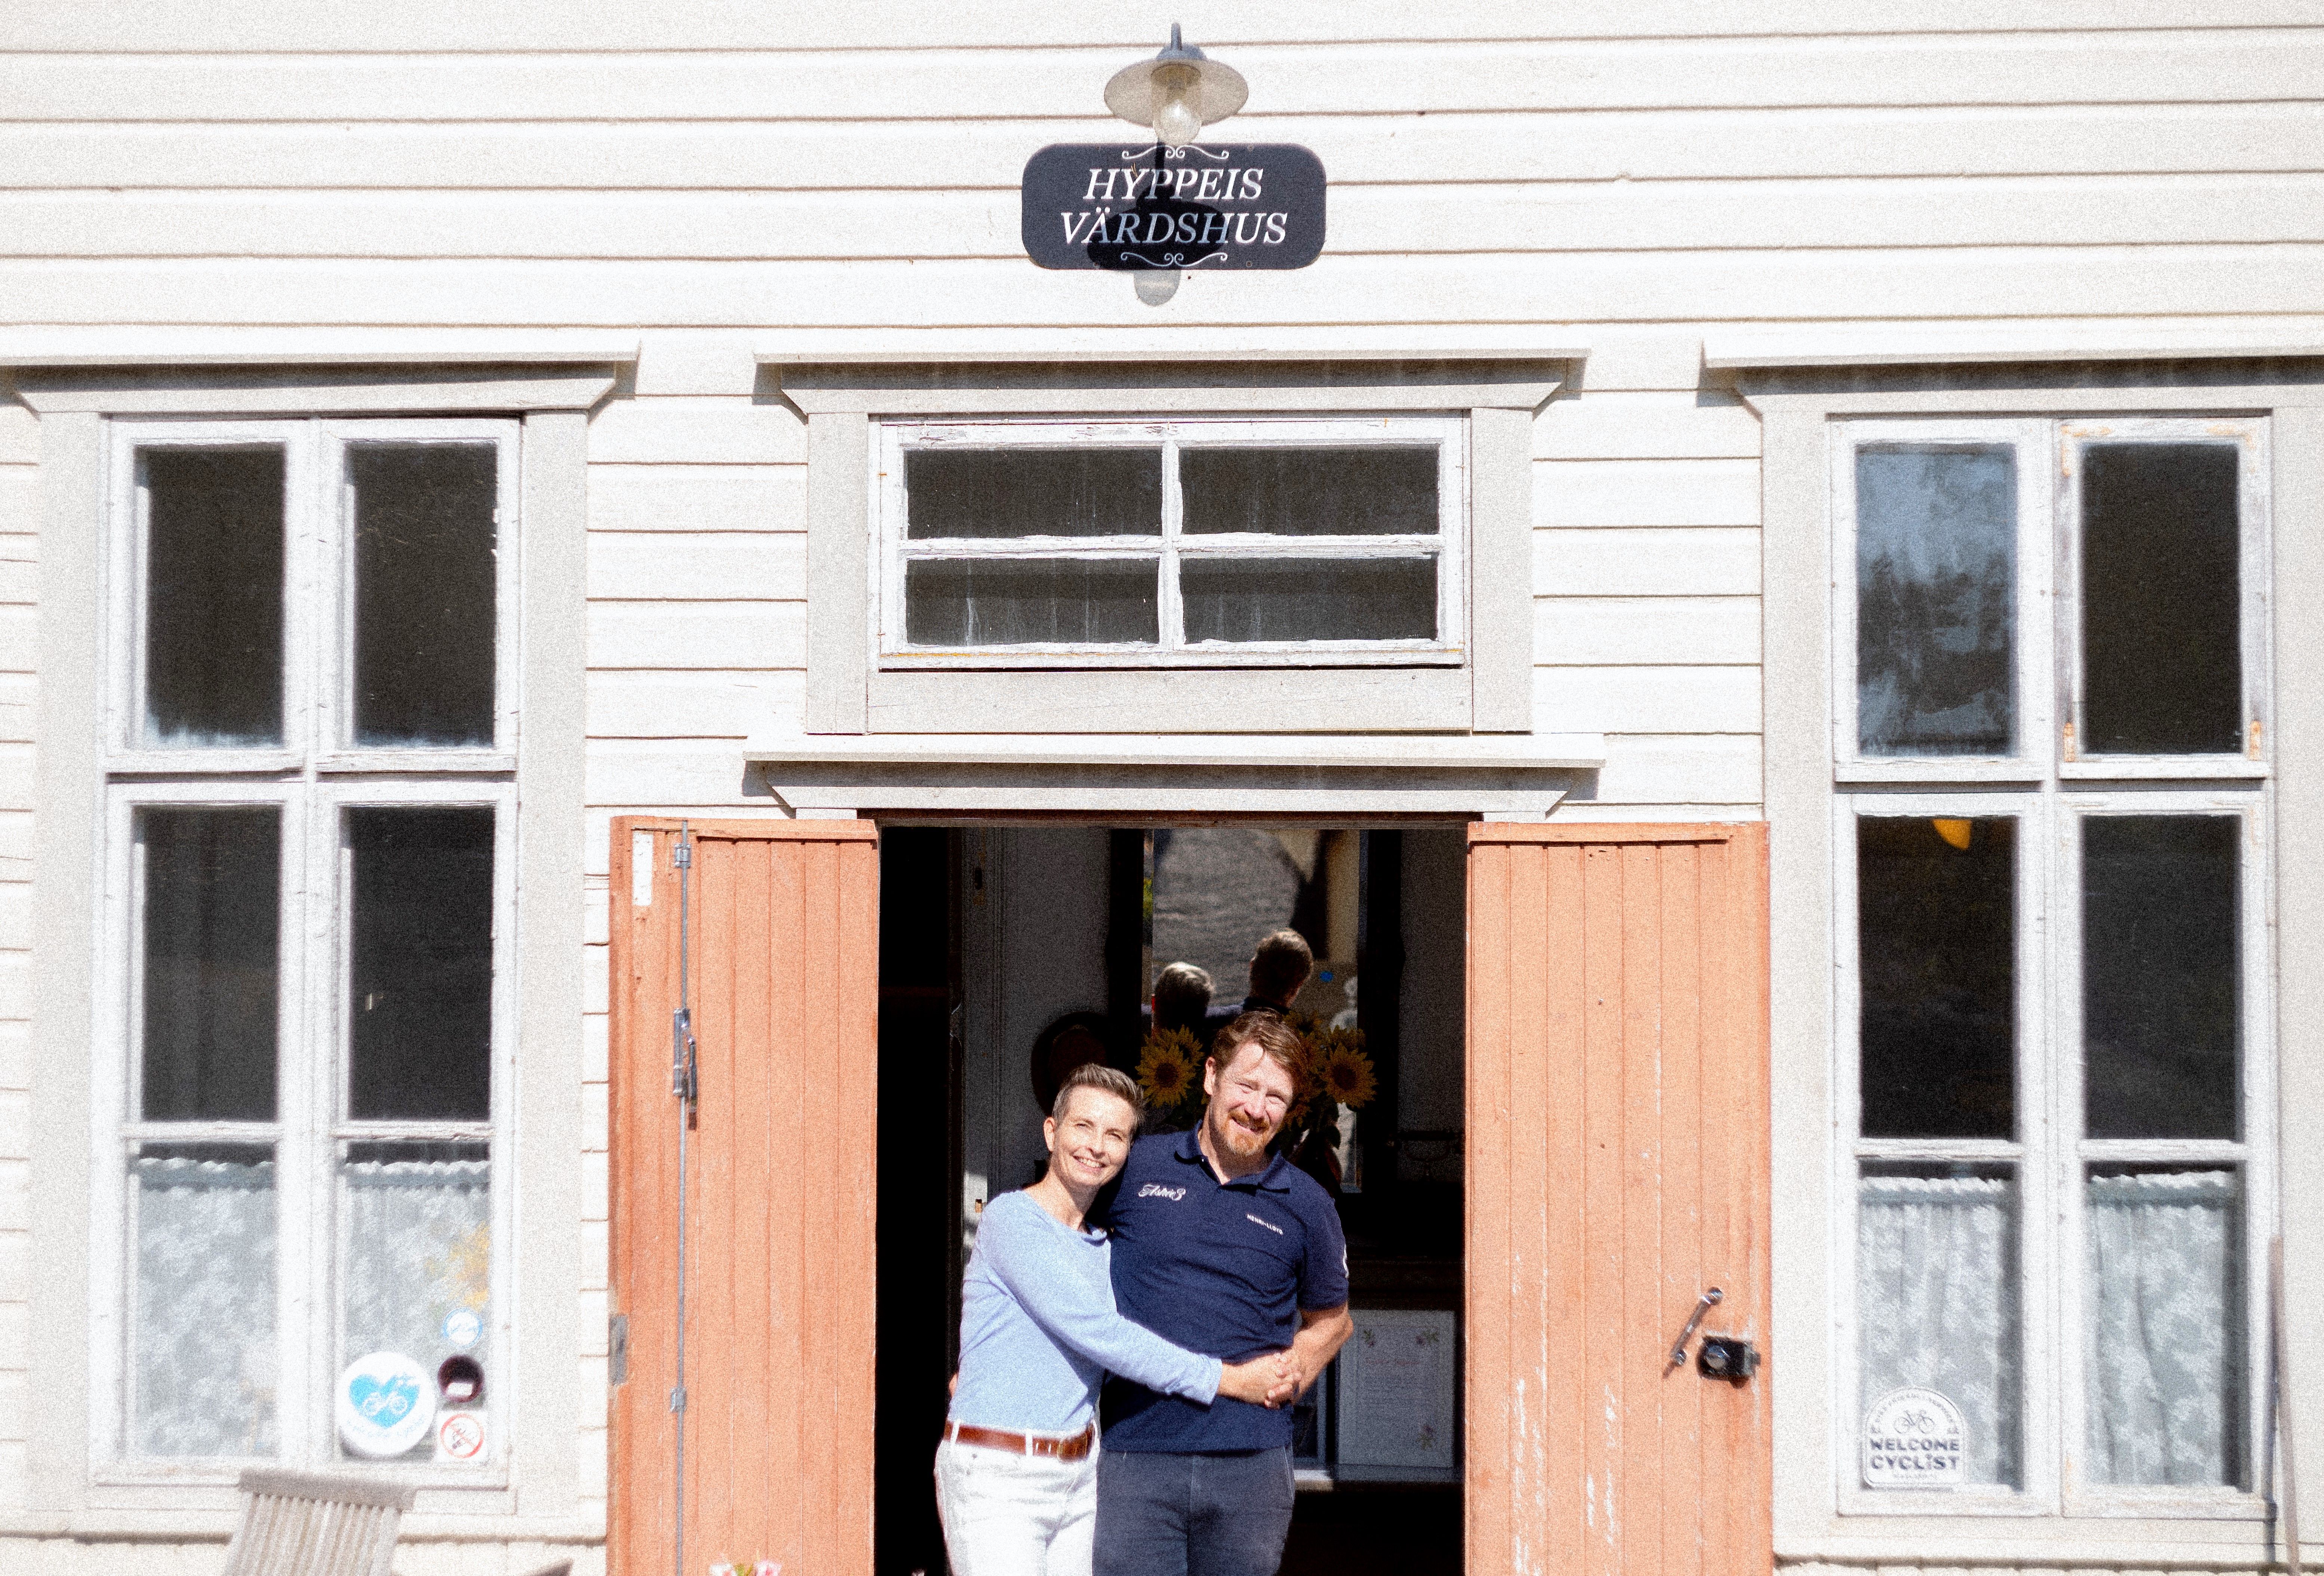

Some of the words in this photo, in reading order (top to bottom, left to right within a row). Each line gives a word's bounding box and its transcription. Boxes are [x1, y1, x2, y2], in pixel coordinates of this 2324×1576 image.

[1082, 167, 1264, 200] HYPPEIS
[1060, 206, 1289, 245] VÄRDSHUS
[1246, 1213, 1284, 1235] HENRI-LLOYD
[1870, 1438, 1959, 1451] WELCOME
